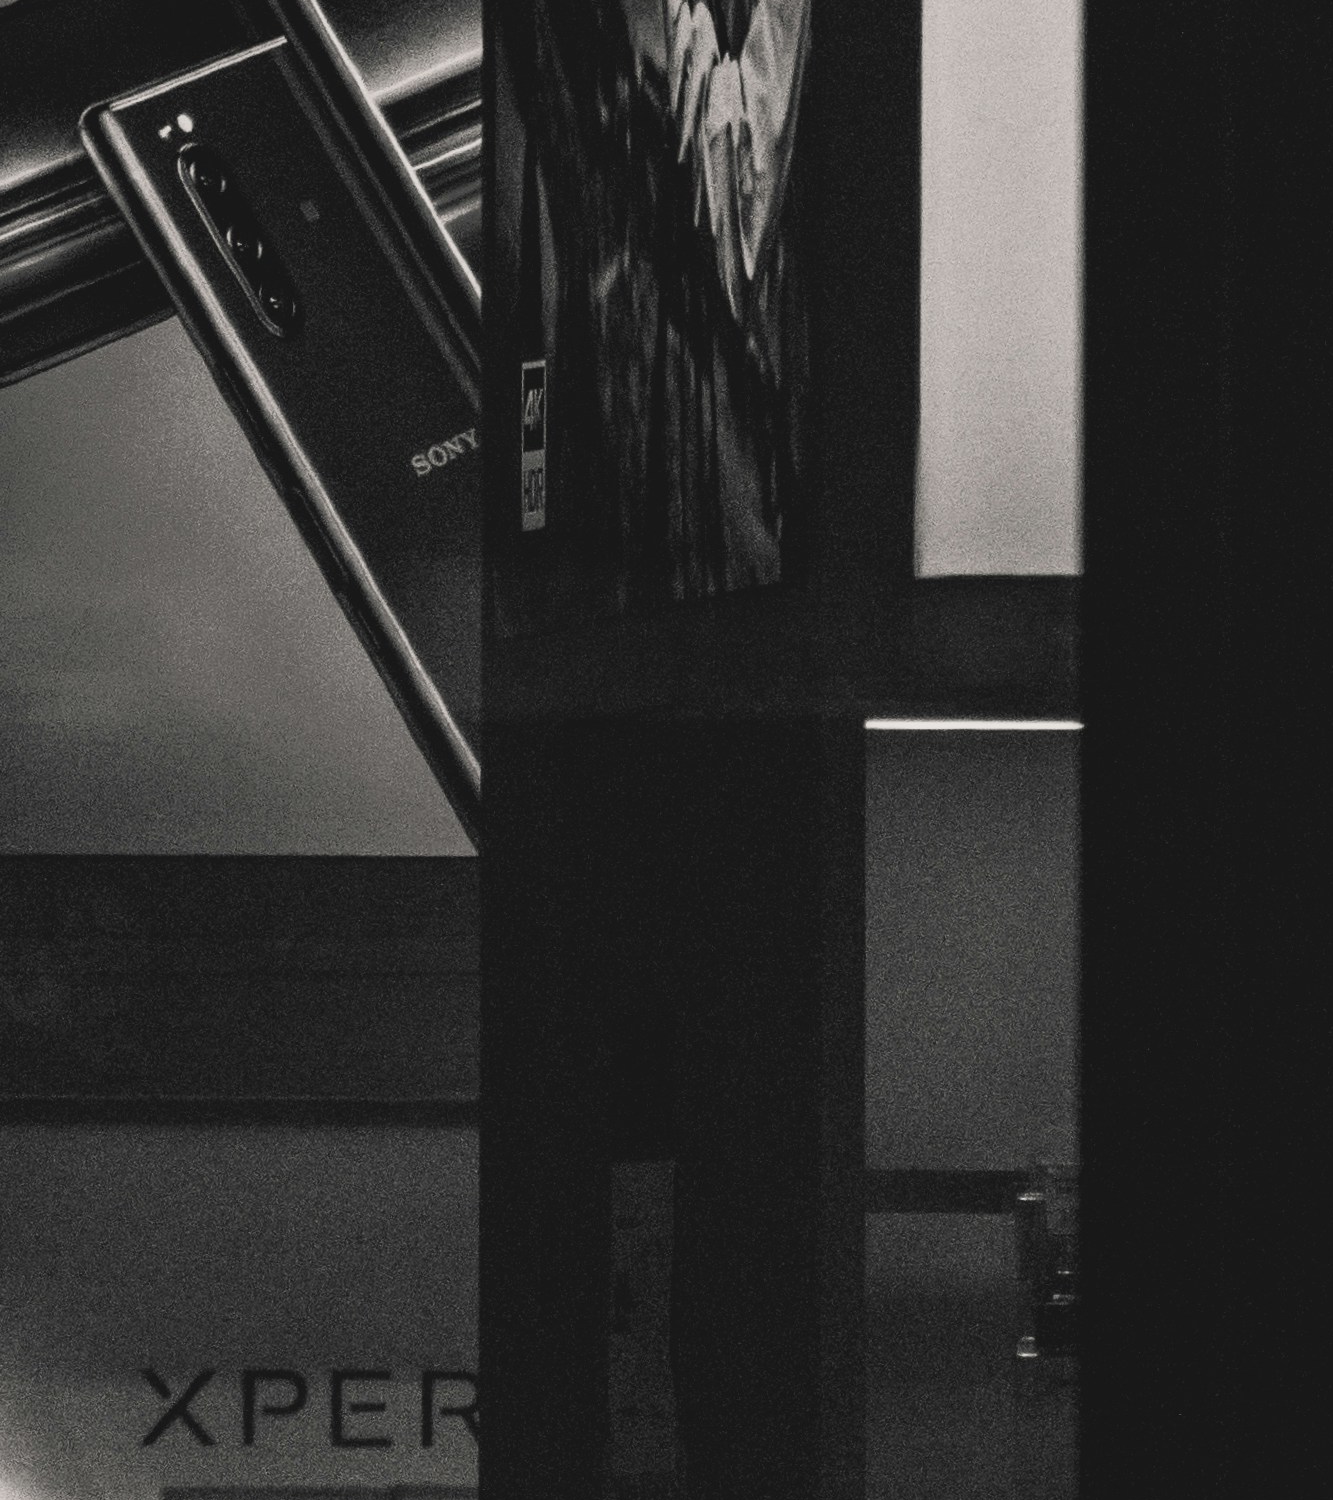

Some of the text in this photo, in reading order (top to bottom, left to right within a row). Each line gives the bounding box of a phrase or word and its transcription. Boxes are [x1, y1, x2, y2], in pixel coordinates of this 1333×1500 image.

[521, 387, 544, 430] 4K
[410, 428, 479, 477] SONY
[142, 1369, 479, 1448] XPER
